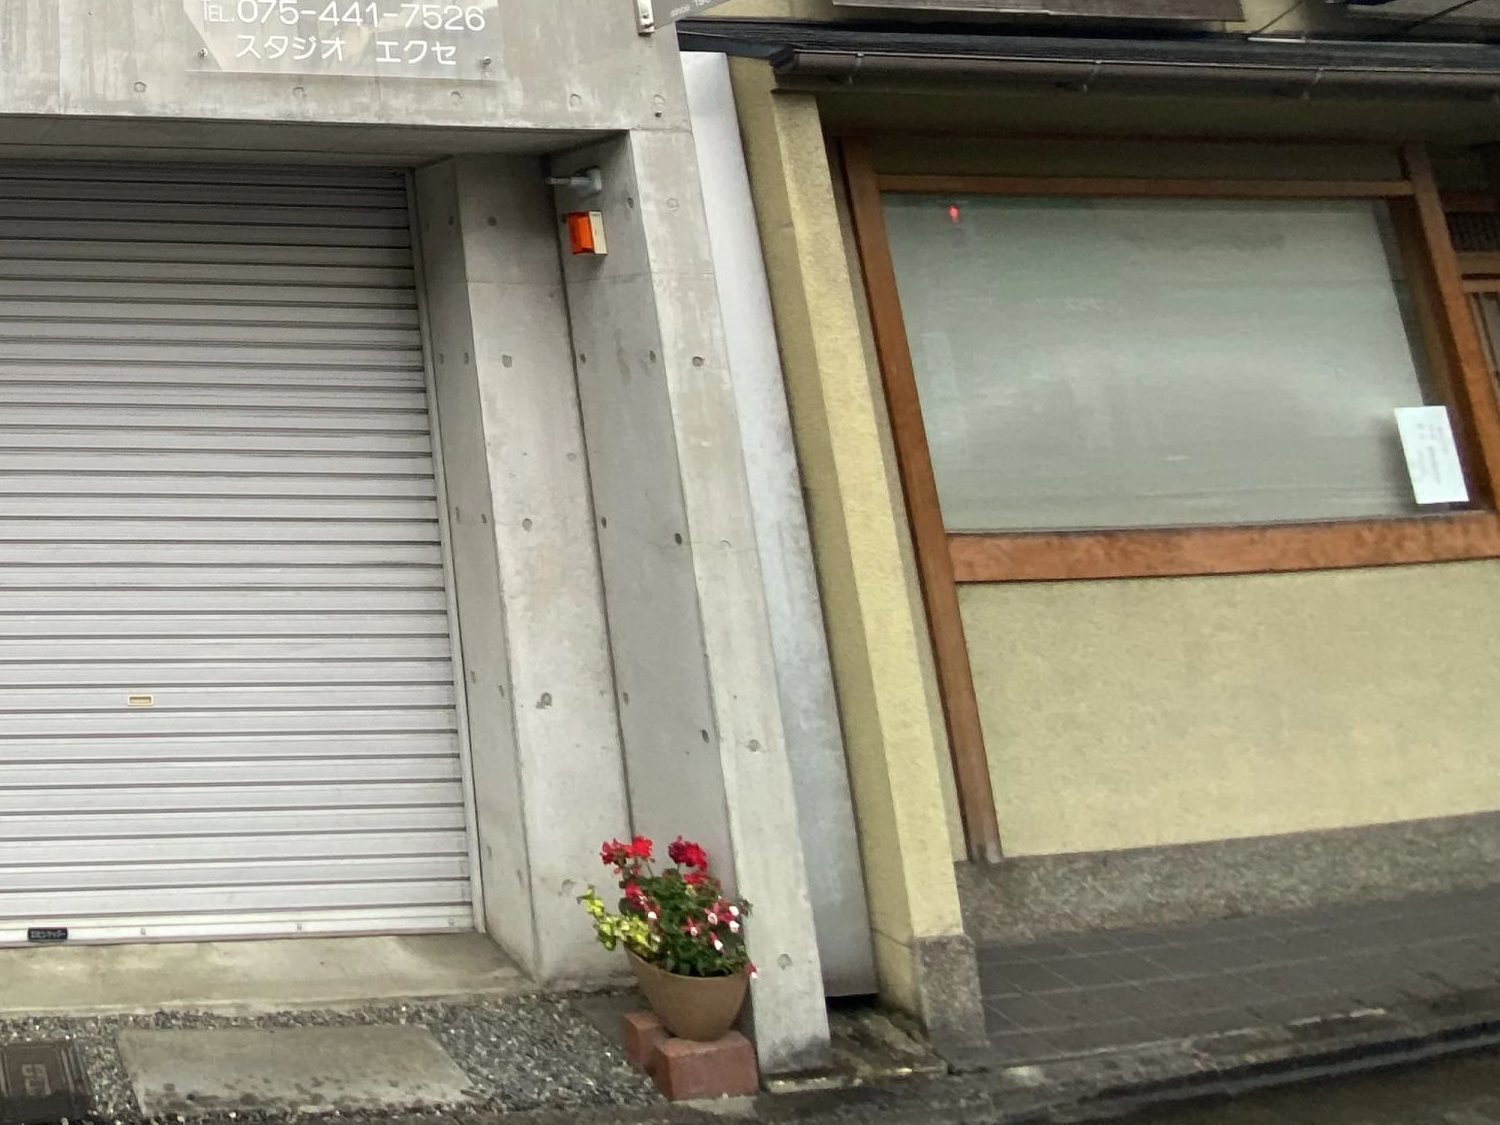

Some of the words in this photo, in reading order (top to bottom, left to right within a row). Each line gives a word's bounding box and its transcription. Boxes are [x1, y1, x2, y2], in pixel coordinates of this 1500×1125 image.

[236, 35, 346, 61] スタジオ
[376, 40, 457, 65] エクセ
